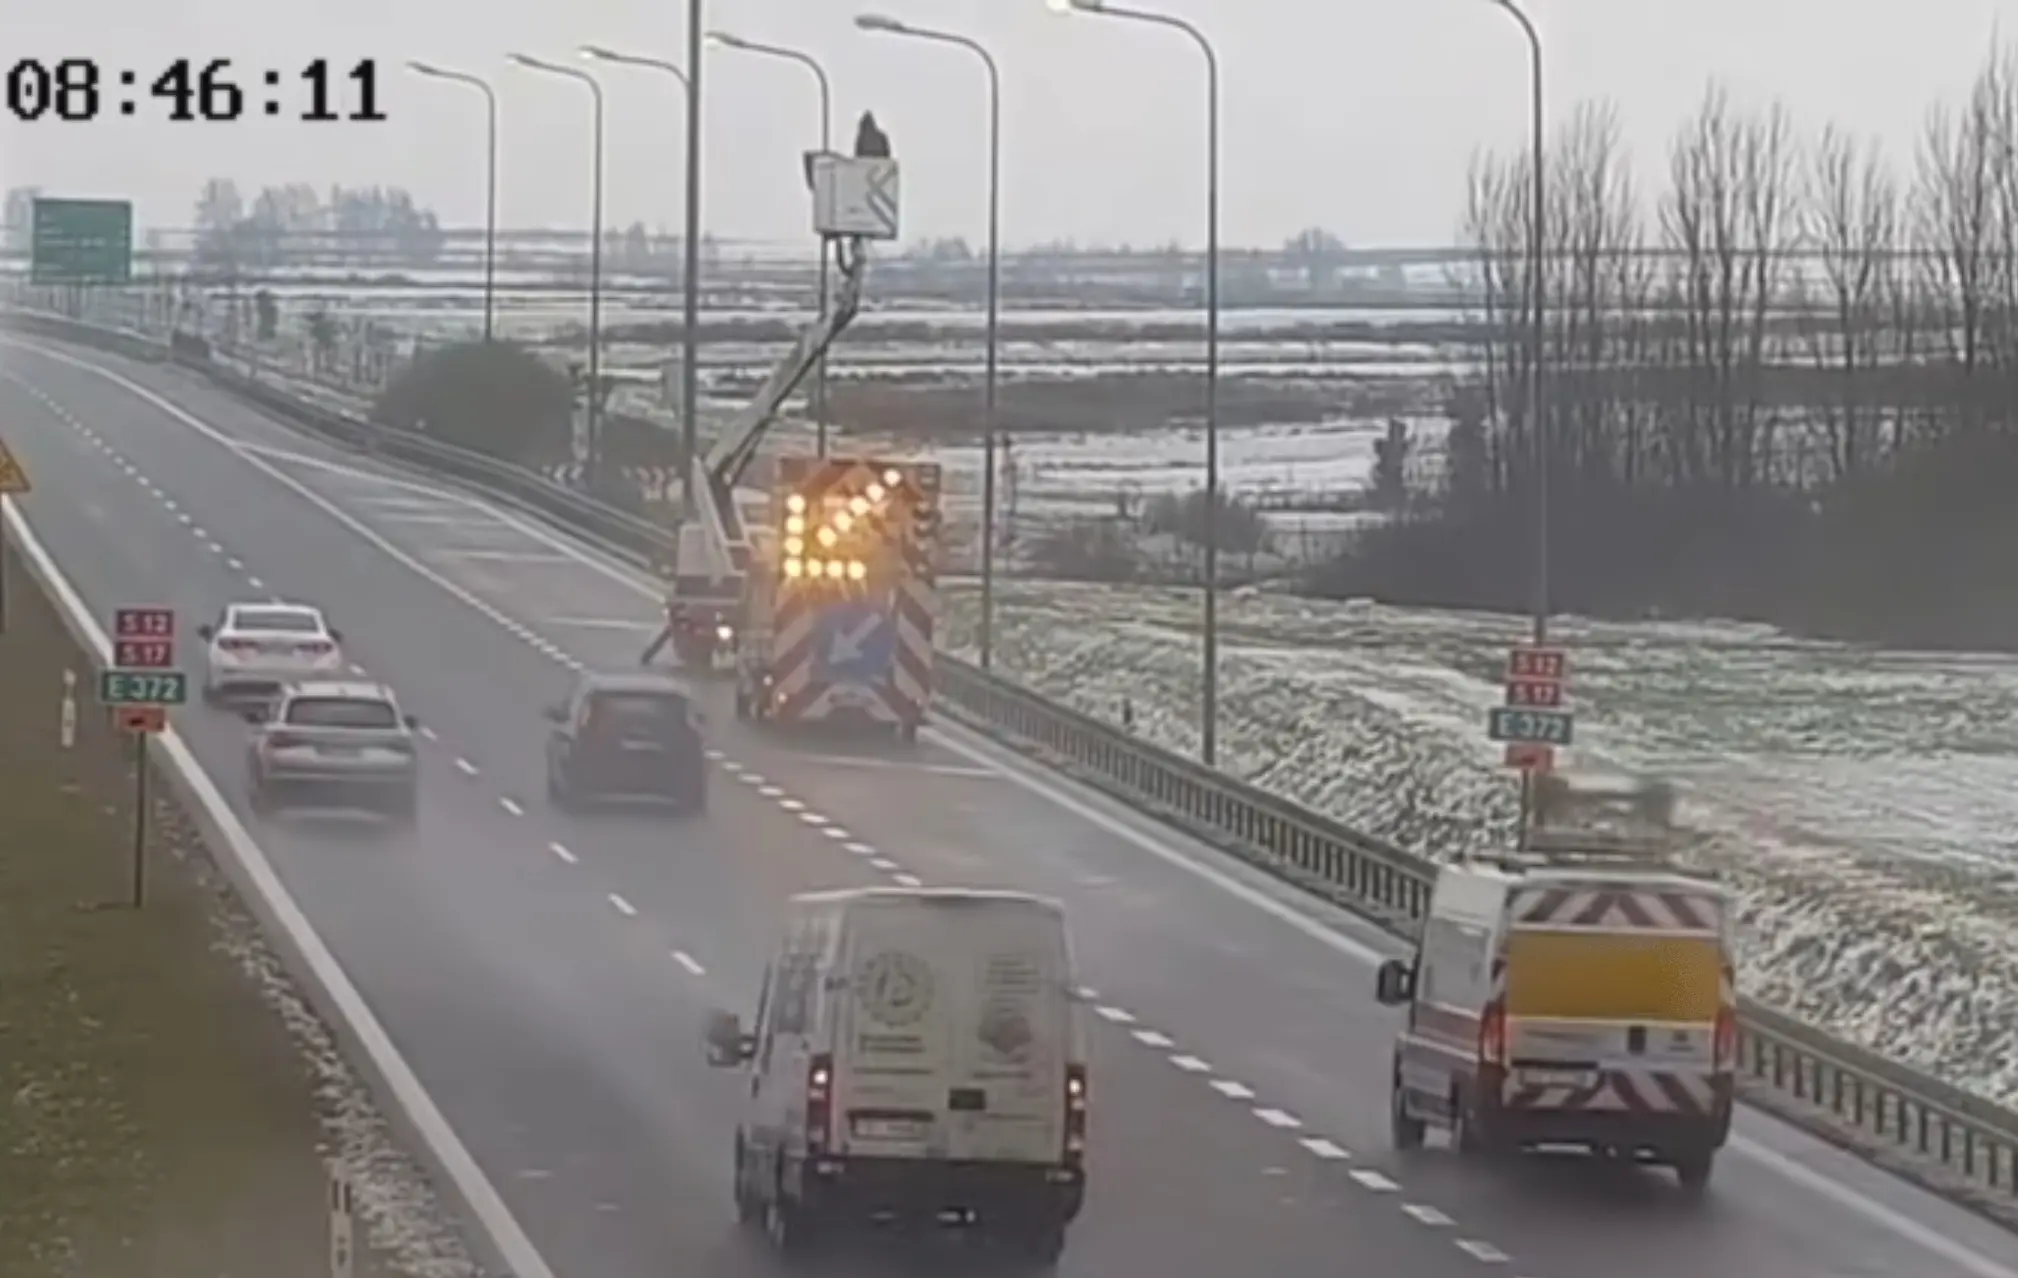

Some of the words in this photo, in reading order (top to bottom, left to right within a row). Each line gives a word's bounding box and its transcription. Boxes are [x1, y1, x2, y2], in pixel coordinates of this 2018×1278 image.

[108, 676, 125, 698] E
[131, 676, 180, 700] 372
[1498, 712, 1514, 737] E
[1518, 714, 1564, 739] 372
